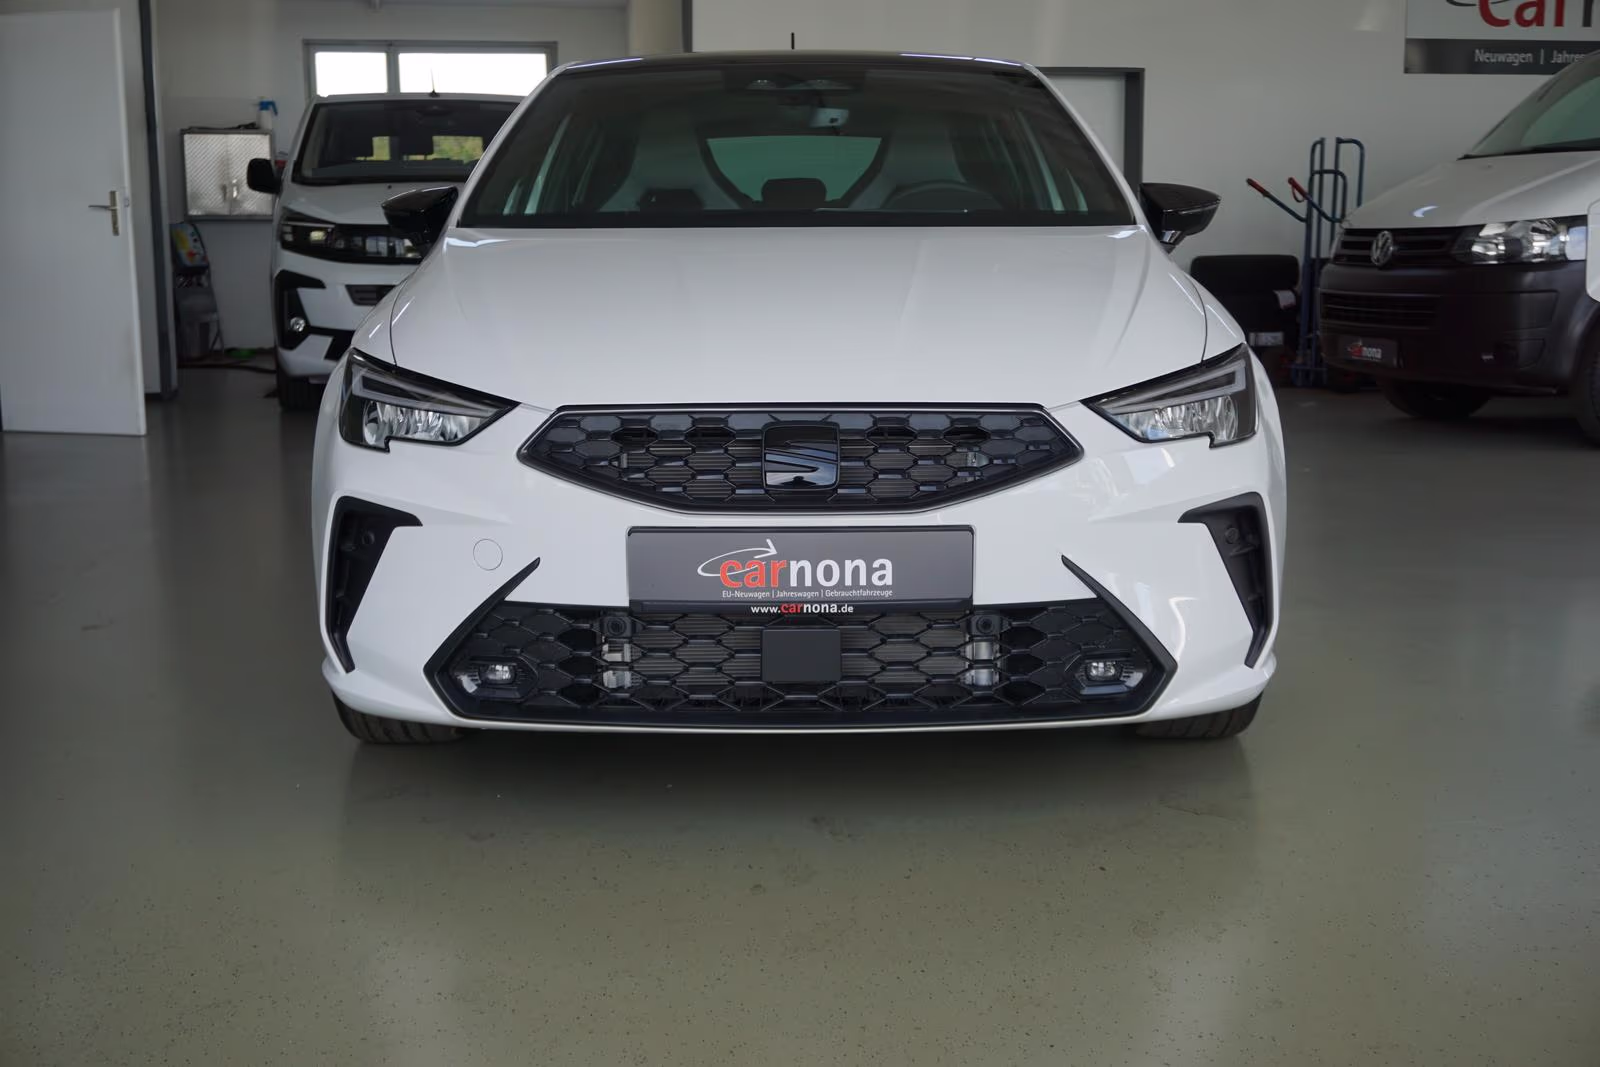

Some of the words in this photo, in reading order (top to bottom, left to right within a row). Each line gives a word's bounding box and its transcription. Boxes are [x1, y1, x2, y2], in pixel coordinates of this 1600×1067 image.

[1474, 49, 1533, 66] Neuwagen
[719, 558, 893, 588] carnona
[722, 590, 770, 599] EU-Neuwagen
[775, 590, 819, 599] Jahreswagen
[825, 588, 893, 598] Gebrauchtfahrzeuge
[750, 603, 854, 614] www.carnona.de
